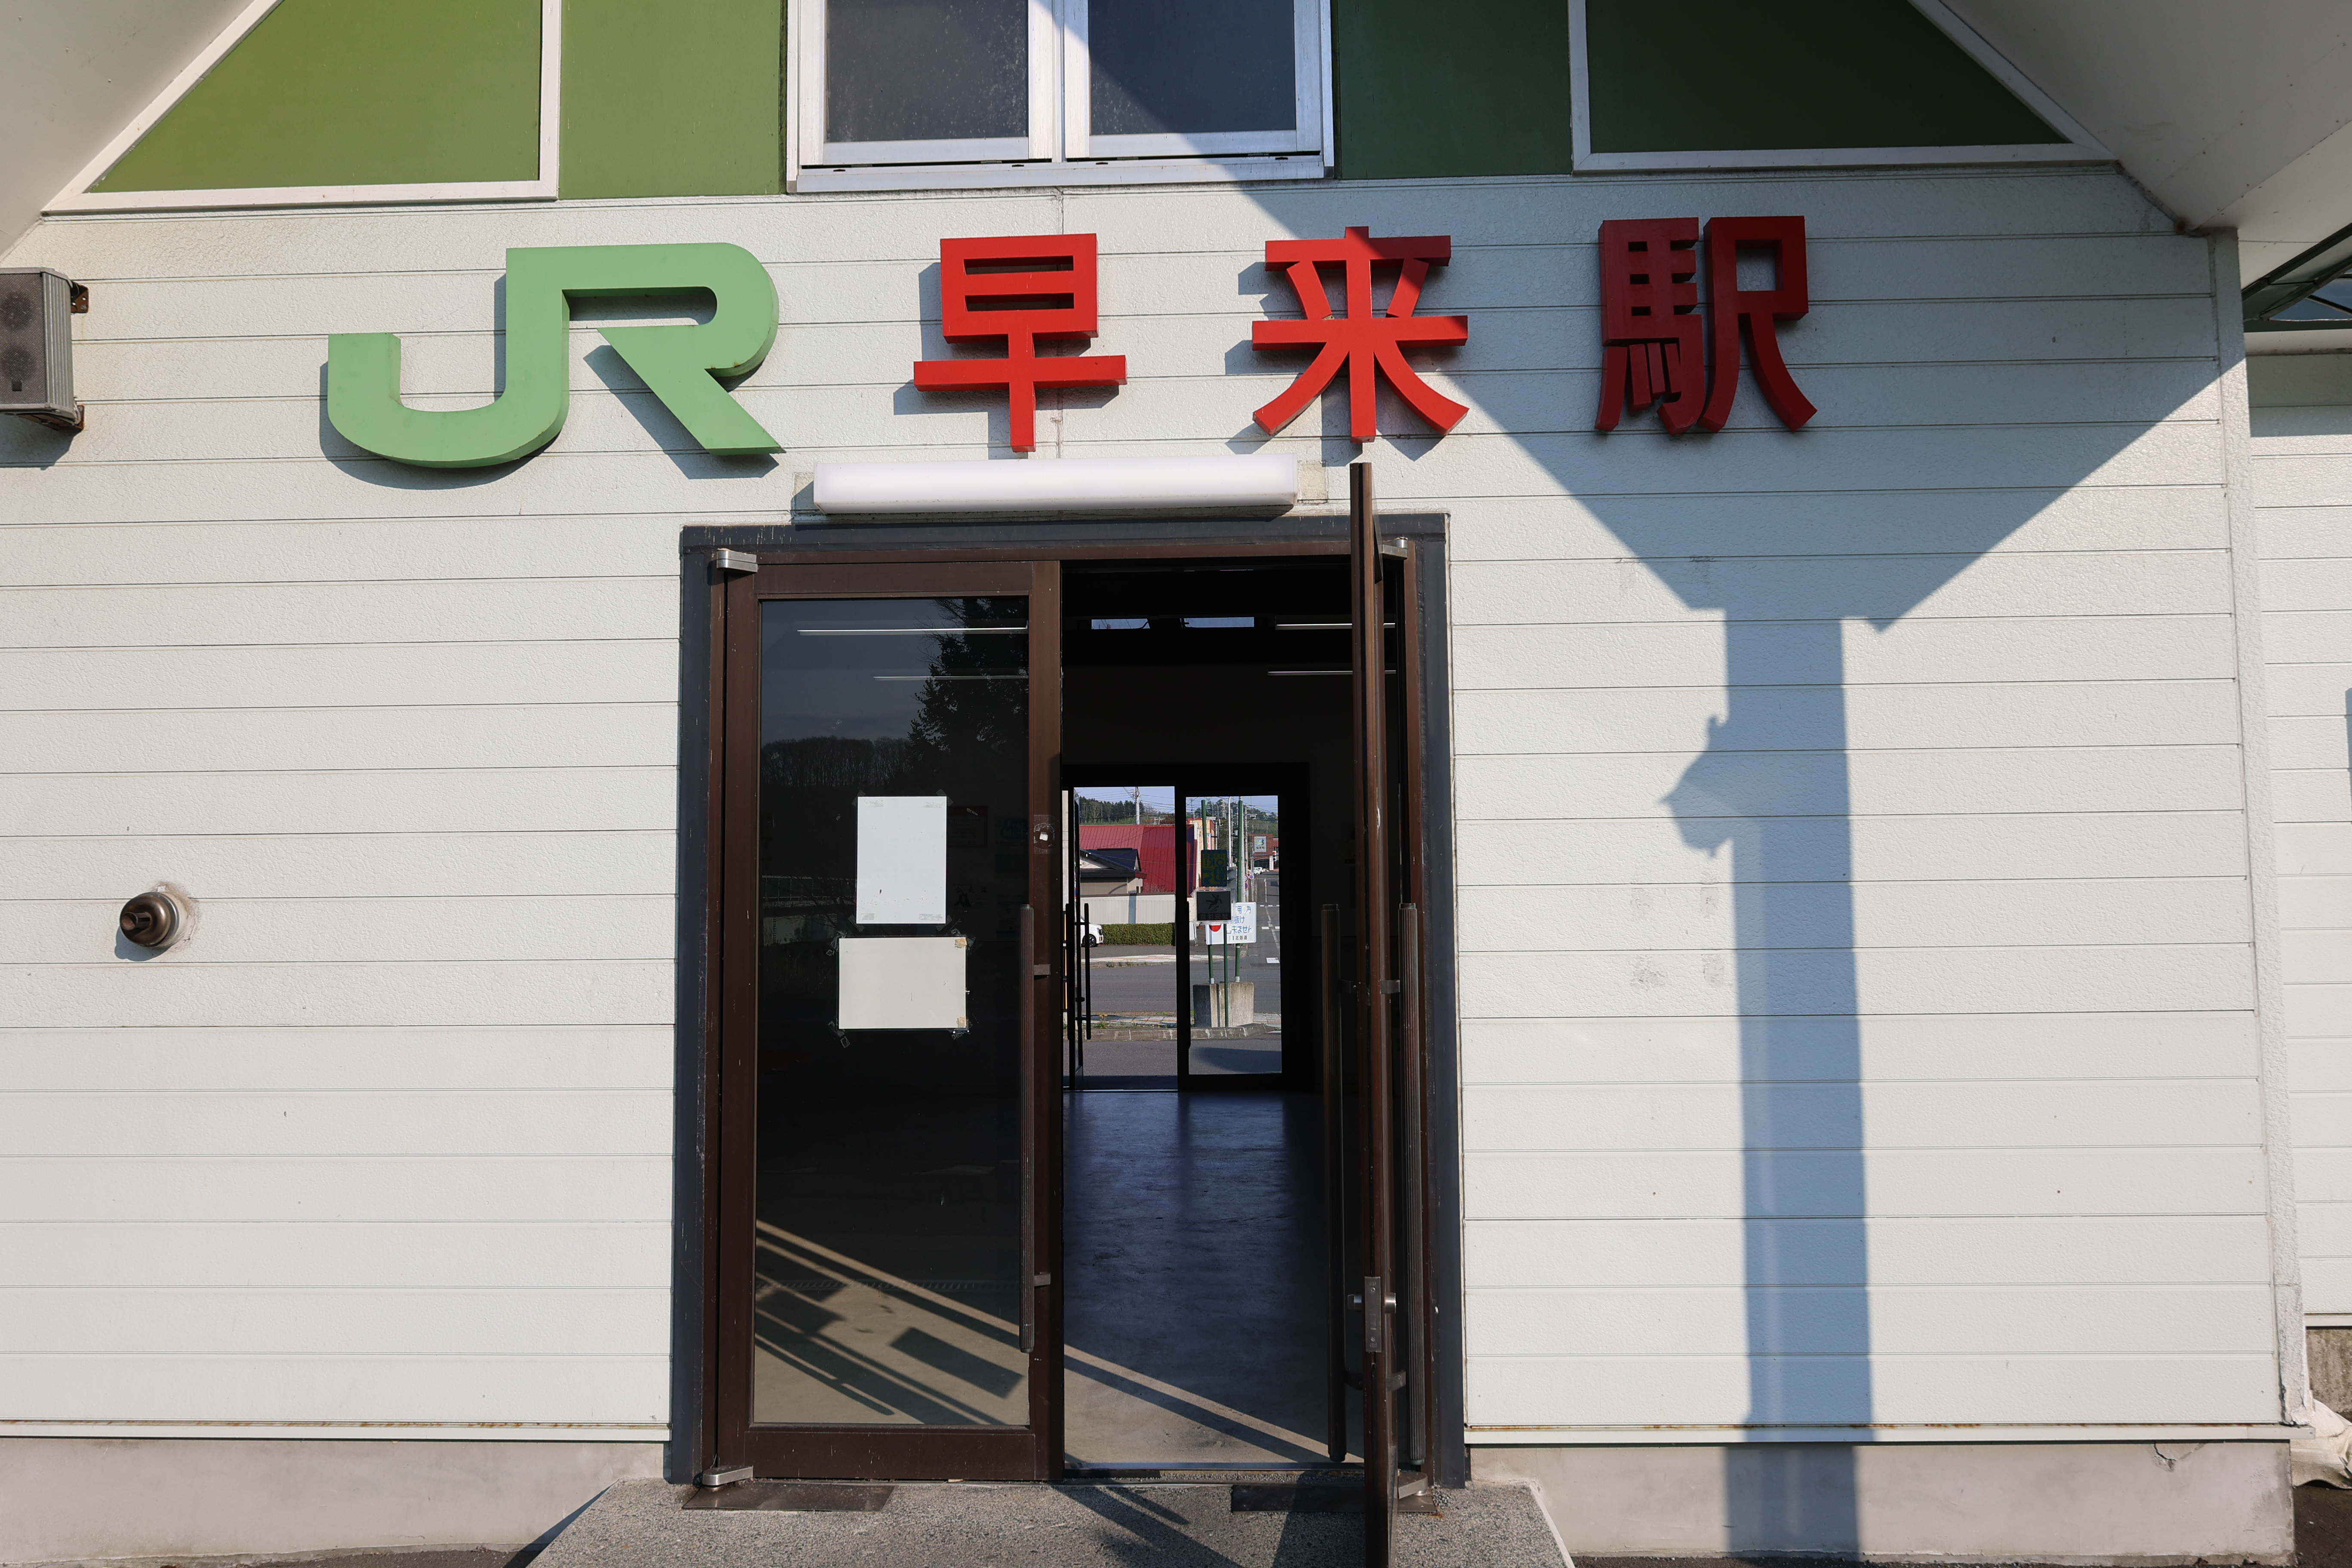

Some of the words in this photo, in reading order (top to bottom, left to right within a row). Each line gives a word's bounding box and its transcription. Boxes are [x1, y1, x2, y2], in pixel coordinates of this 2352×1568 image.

[327, 242, 784, 469] JR
[913, 216, 1818, 454] 早来駅
